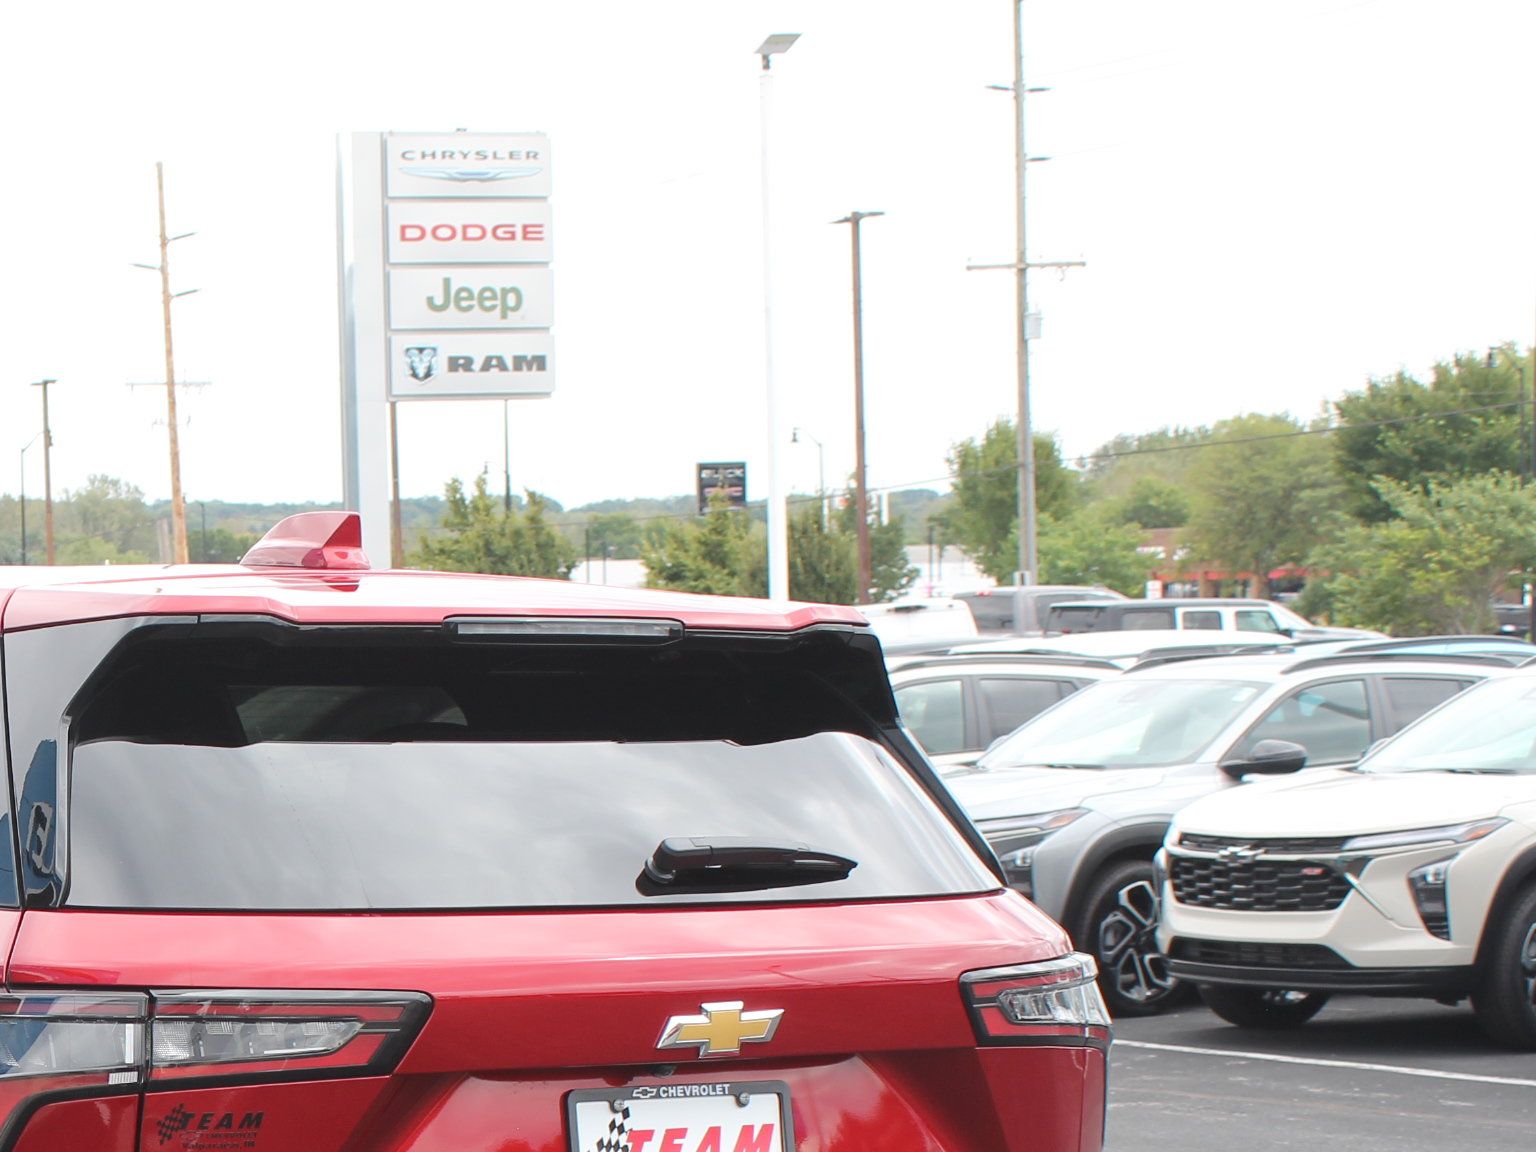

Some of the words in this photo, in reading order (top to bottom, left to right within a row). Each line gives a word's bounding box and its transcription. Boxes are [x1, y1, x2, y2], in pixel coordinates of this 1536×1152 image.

[400, 150, 541, 161] CHRYSLER
[399, 223, 545, 242] DODGE
[425, 277, 523, 320] Jeep
[447, 354, 548, 373] RAM
[659, 1083, 731, 1098] CHEVROLET
[180, 1111, 264, 1131] TEAM
